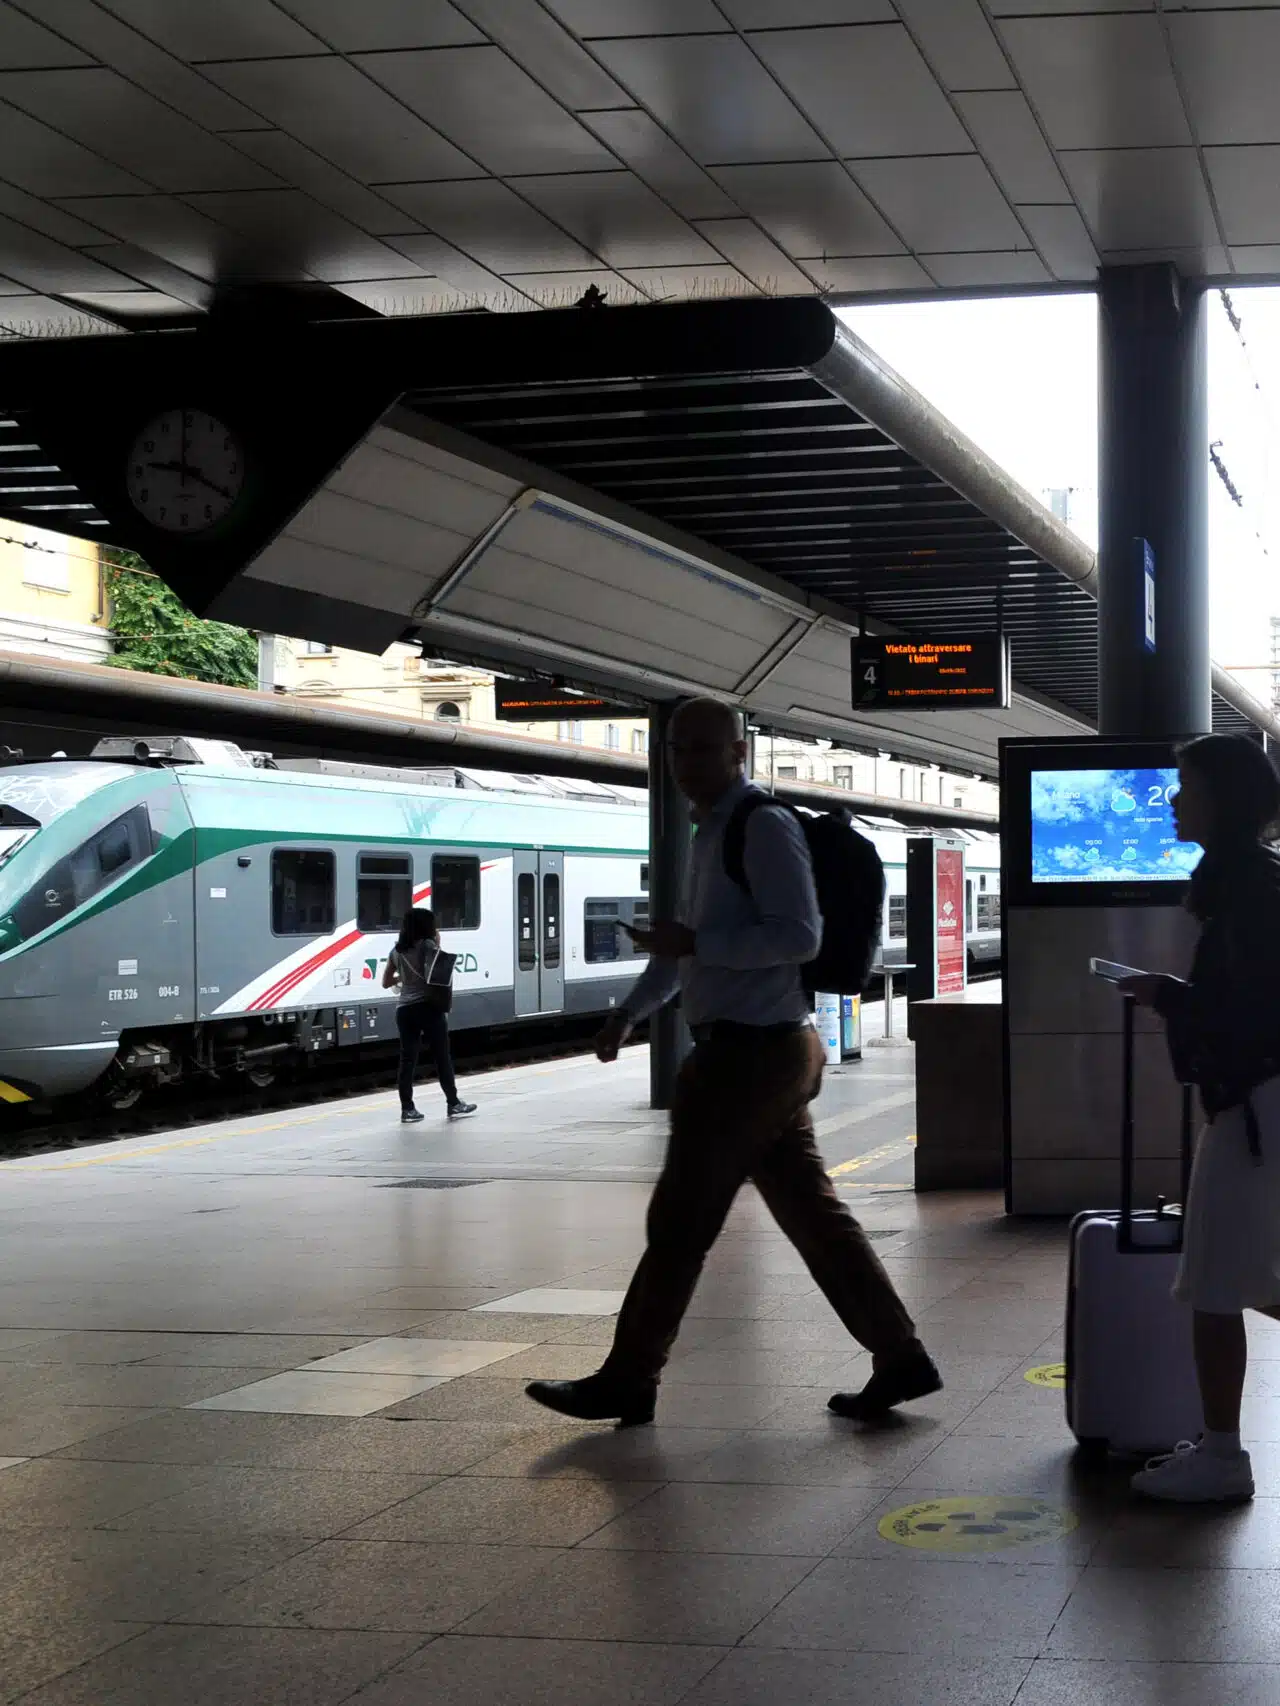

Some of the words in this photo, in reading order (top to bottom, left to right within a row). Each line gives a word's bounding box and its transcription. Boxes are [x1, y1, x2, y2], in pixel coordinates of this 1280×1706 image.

[885, 644, 917, 654] Vietato
[918, 644, 972, 653] attraversare
[914, 654, 938, 663] binari
[863, 666, 877, 684] 4
[108, 989, 123, 1001] ETR
[123, 988, 139, 1000] 526
